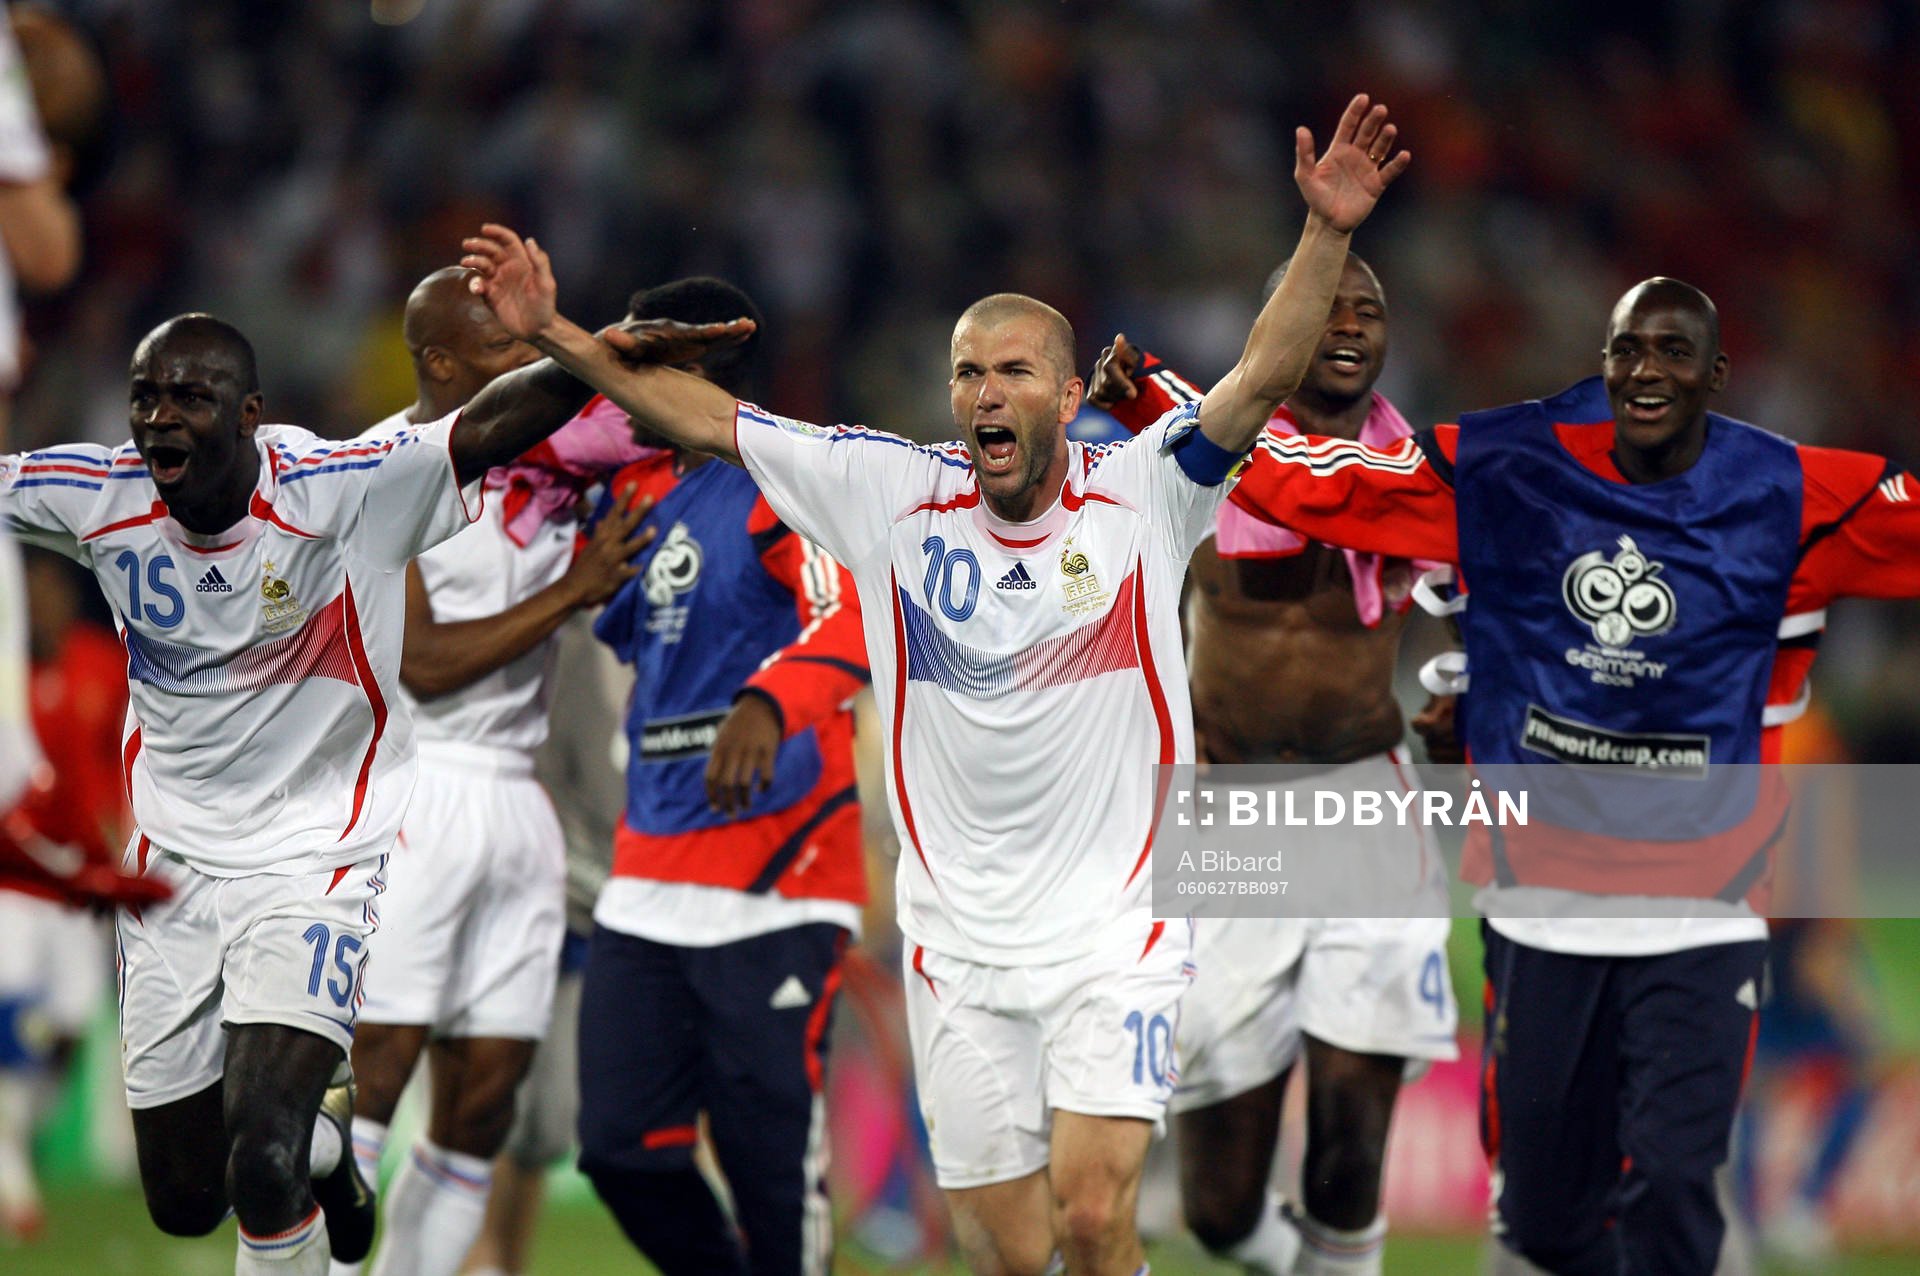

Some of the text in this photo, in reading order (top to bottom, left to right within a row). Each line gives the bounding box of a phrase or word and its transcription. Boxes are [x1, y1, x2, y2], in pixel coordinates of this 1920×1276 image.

[115, 550, 185, 628] 15
[196, 583, 232, 593] adidas
[922, 536, 981, 622] 10
[996, 579, 1036, 590] adidas
[302, 923, 362, 1008] 15
[1418, 949, 1445, 1022] 4
[1123, 1010, 1170, 1088] 10
